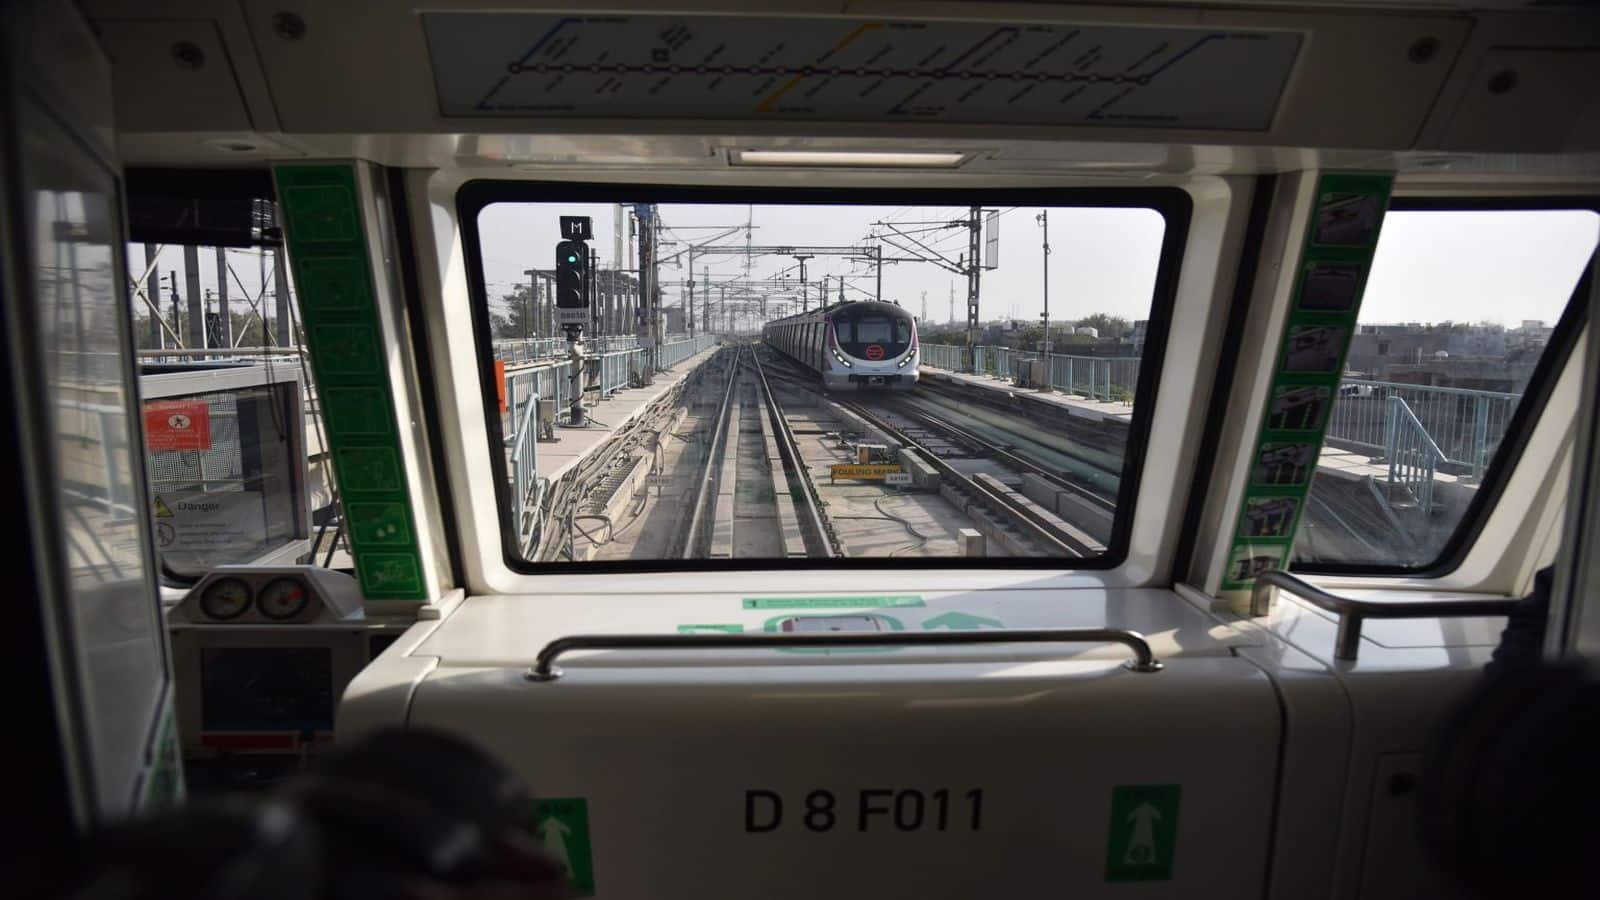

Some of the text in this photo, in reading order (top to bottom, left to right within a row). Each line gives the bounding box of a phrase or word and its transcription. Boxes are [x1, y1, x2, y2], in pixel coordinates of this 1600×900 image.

[571, 222, 582, 234] M
[178, 501, 220, 512] Danger
[745, 788, 983, 832] D 8 F011
